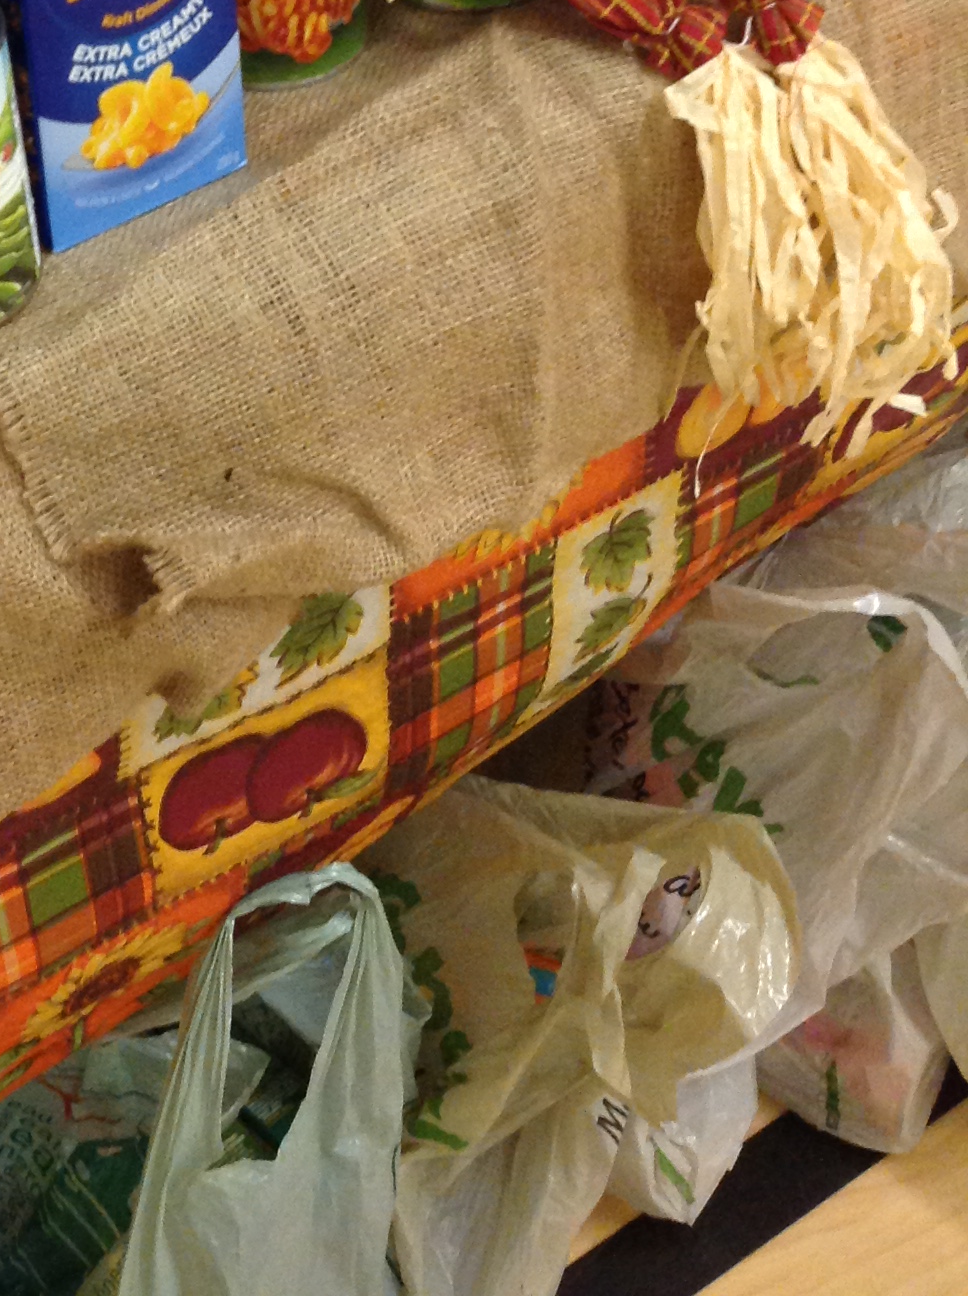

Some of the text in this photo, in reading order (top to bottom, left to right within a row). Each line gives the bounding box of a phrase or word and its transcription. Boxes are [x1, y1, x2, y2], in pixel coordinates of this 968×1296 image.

[69, 6, 213, 84] EXTRA CRÉMEUX
[72, 42, 132, 62] EXTRA
